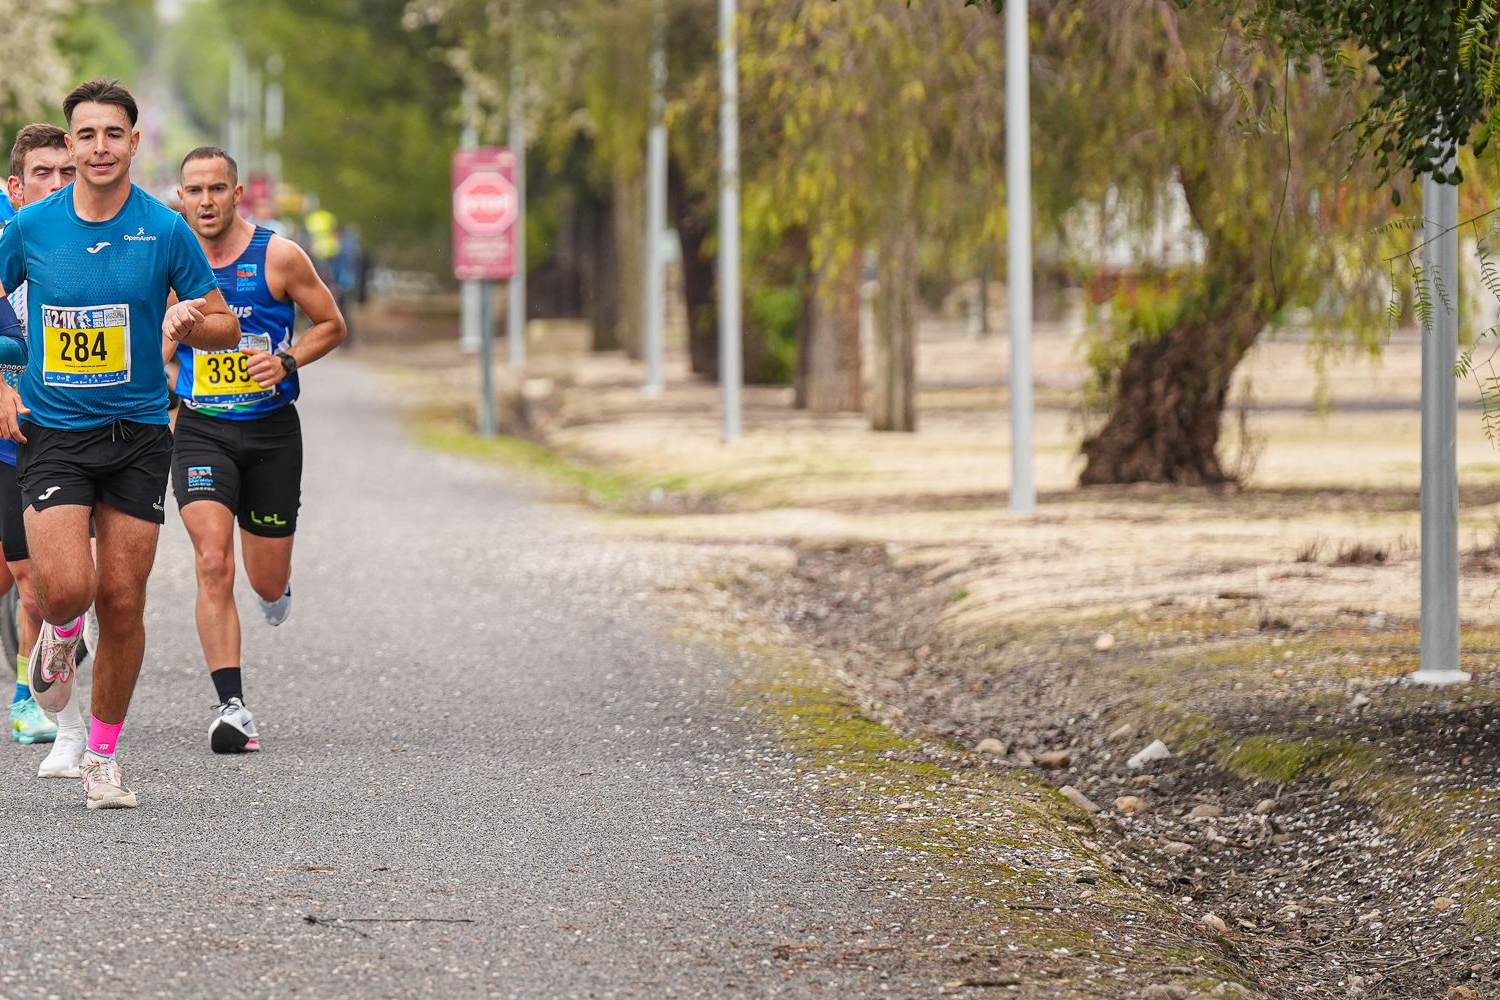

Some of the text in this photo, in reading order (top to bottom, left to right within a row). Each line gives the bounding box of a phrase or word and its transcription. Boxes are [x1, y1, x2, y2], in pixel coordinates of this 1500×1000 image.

[51, 310, 77, 330] 21K
[59, 331, 108, 362] 284
[207, 355, 252, 384] 339
